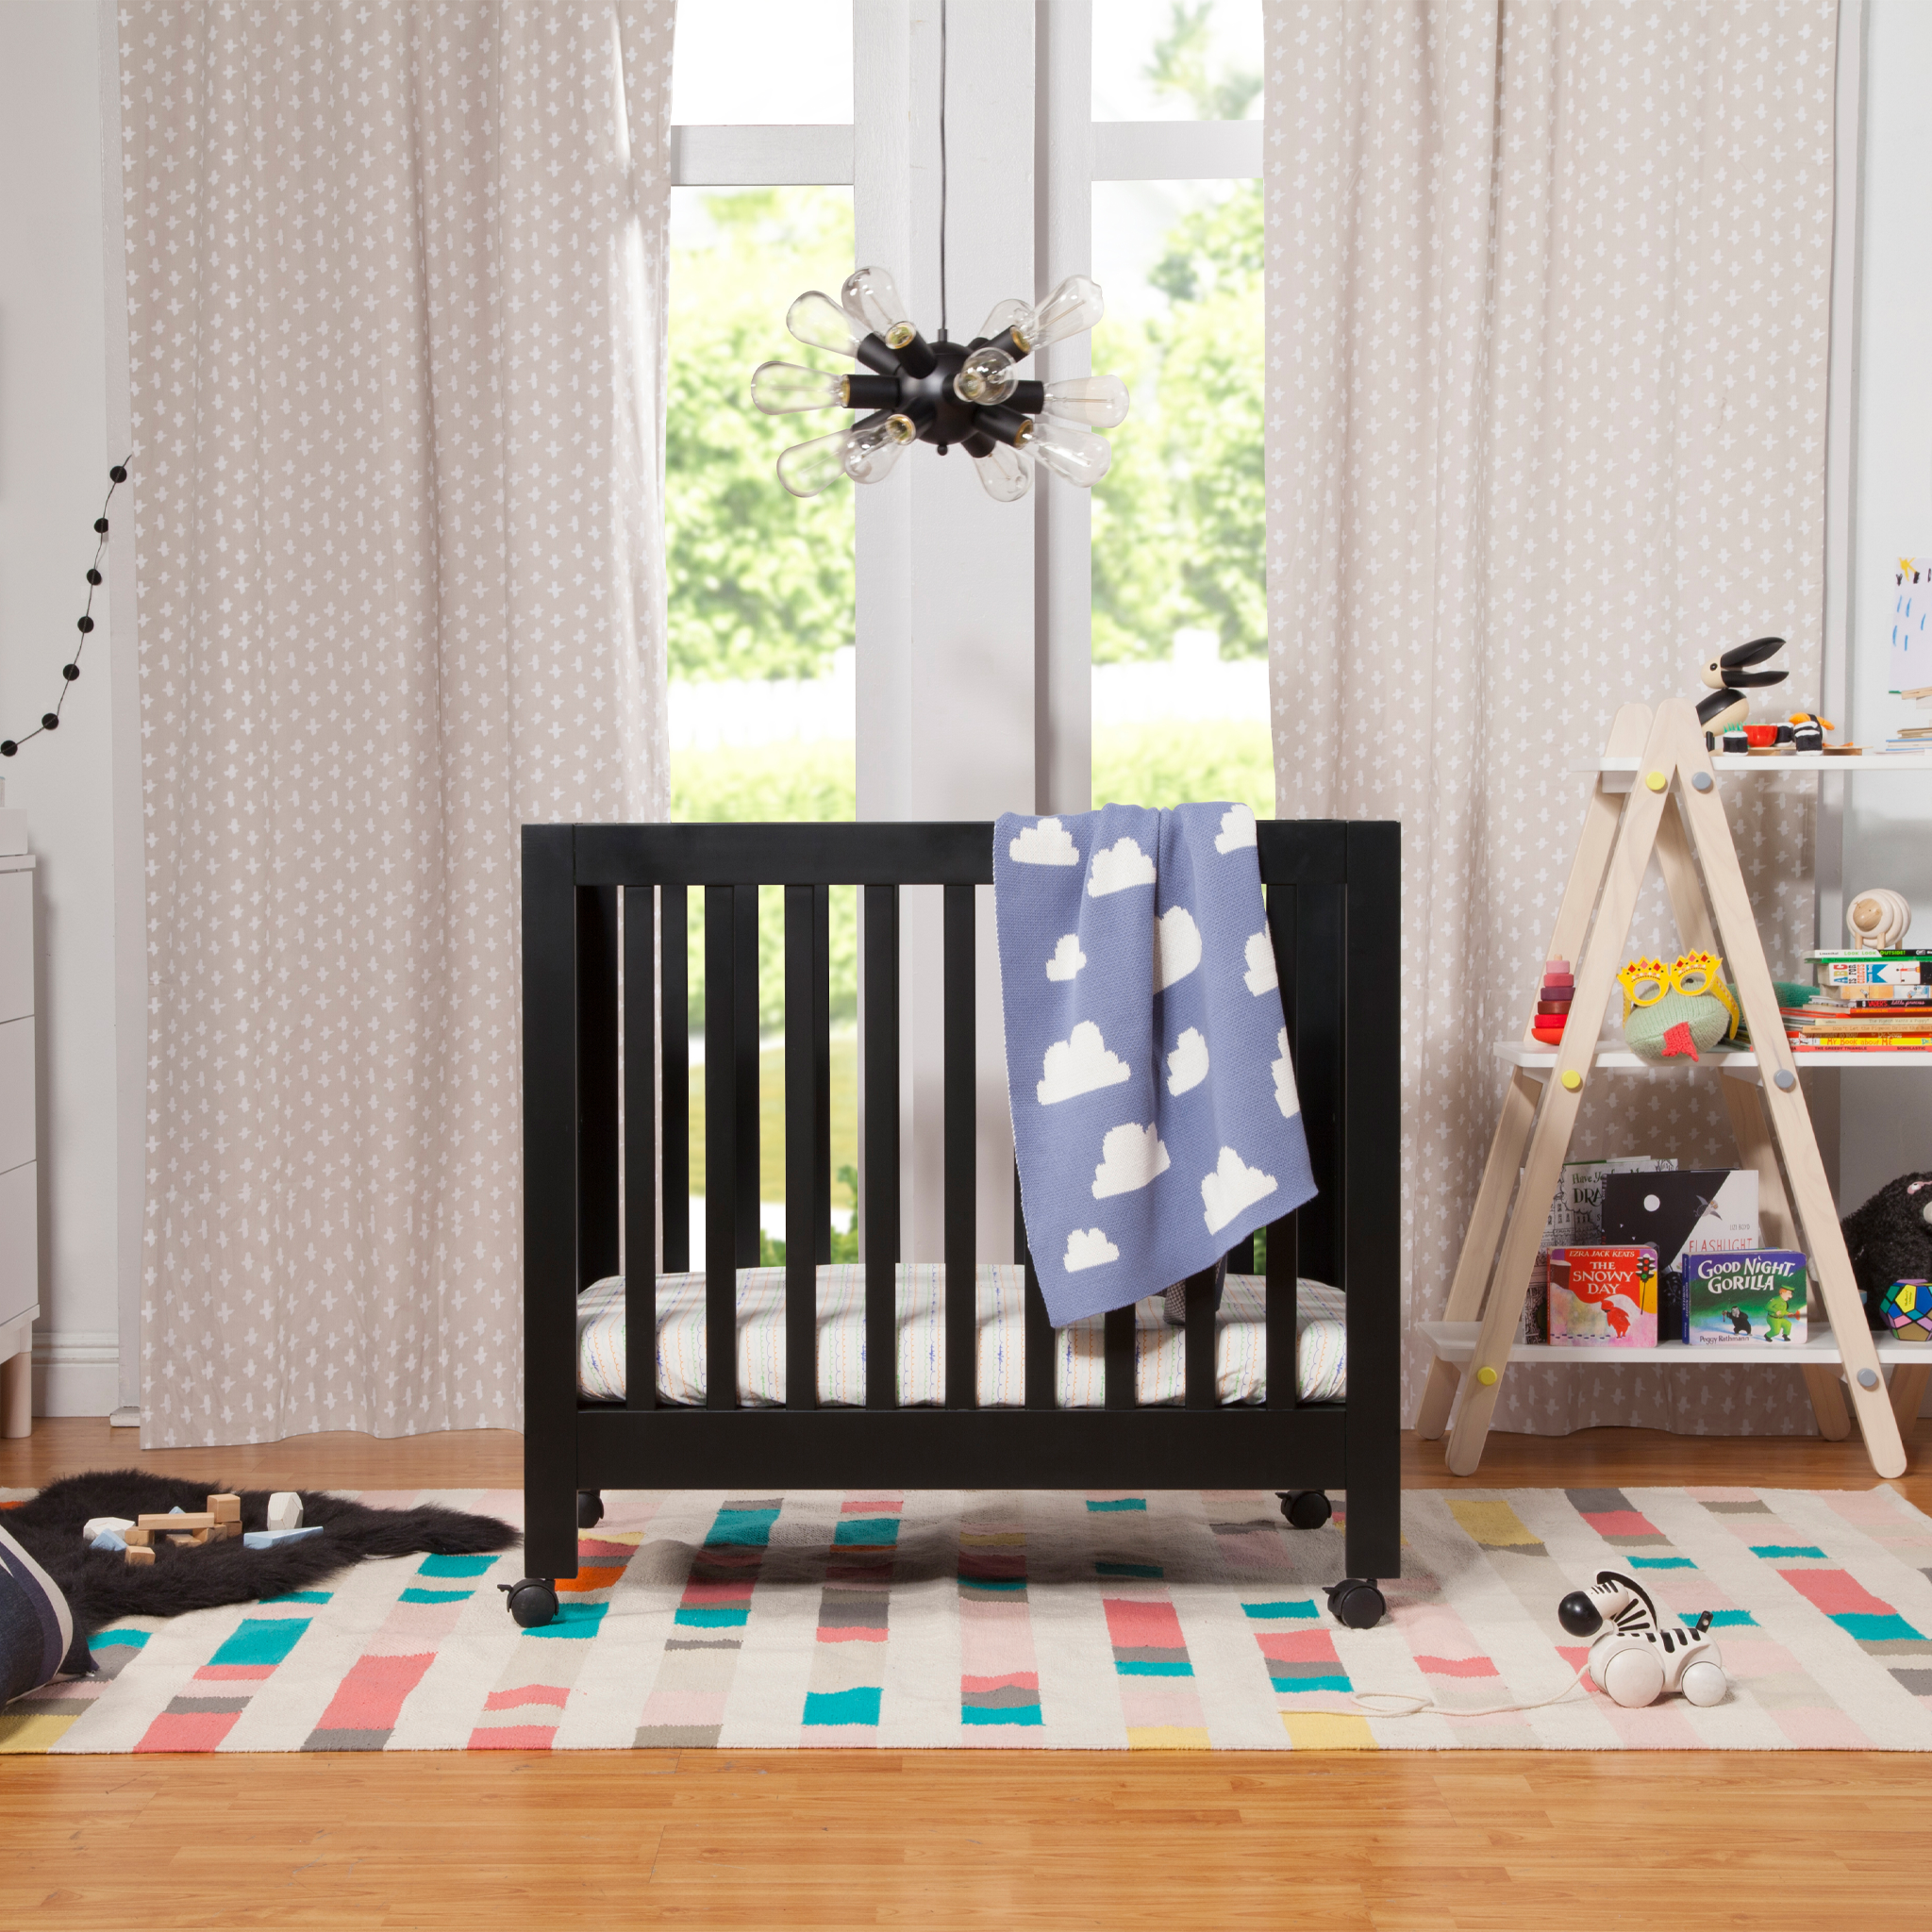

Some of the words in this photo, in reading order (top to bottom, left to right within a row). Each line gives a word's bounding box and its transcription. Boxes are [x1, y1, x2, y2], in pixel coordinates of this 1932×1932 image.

[1833, 964, 1848, 984] ABC
[1848, 964, 1857, 975] FOR
[1572, 1173, 1592, 1185] Have
[1590, 1261, 1616, 1270] THE
[1698, 1259, 1740, 1279] GOOD
[1573, 1271, 1634, 1283] SNOWY
[1587, 1283, 1621, 1294] DAY
[1707, 1274, 1774, 1294] GORILLA
[1699, 1335, 1718, 1345] Peggy
